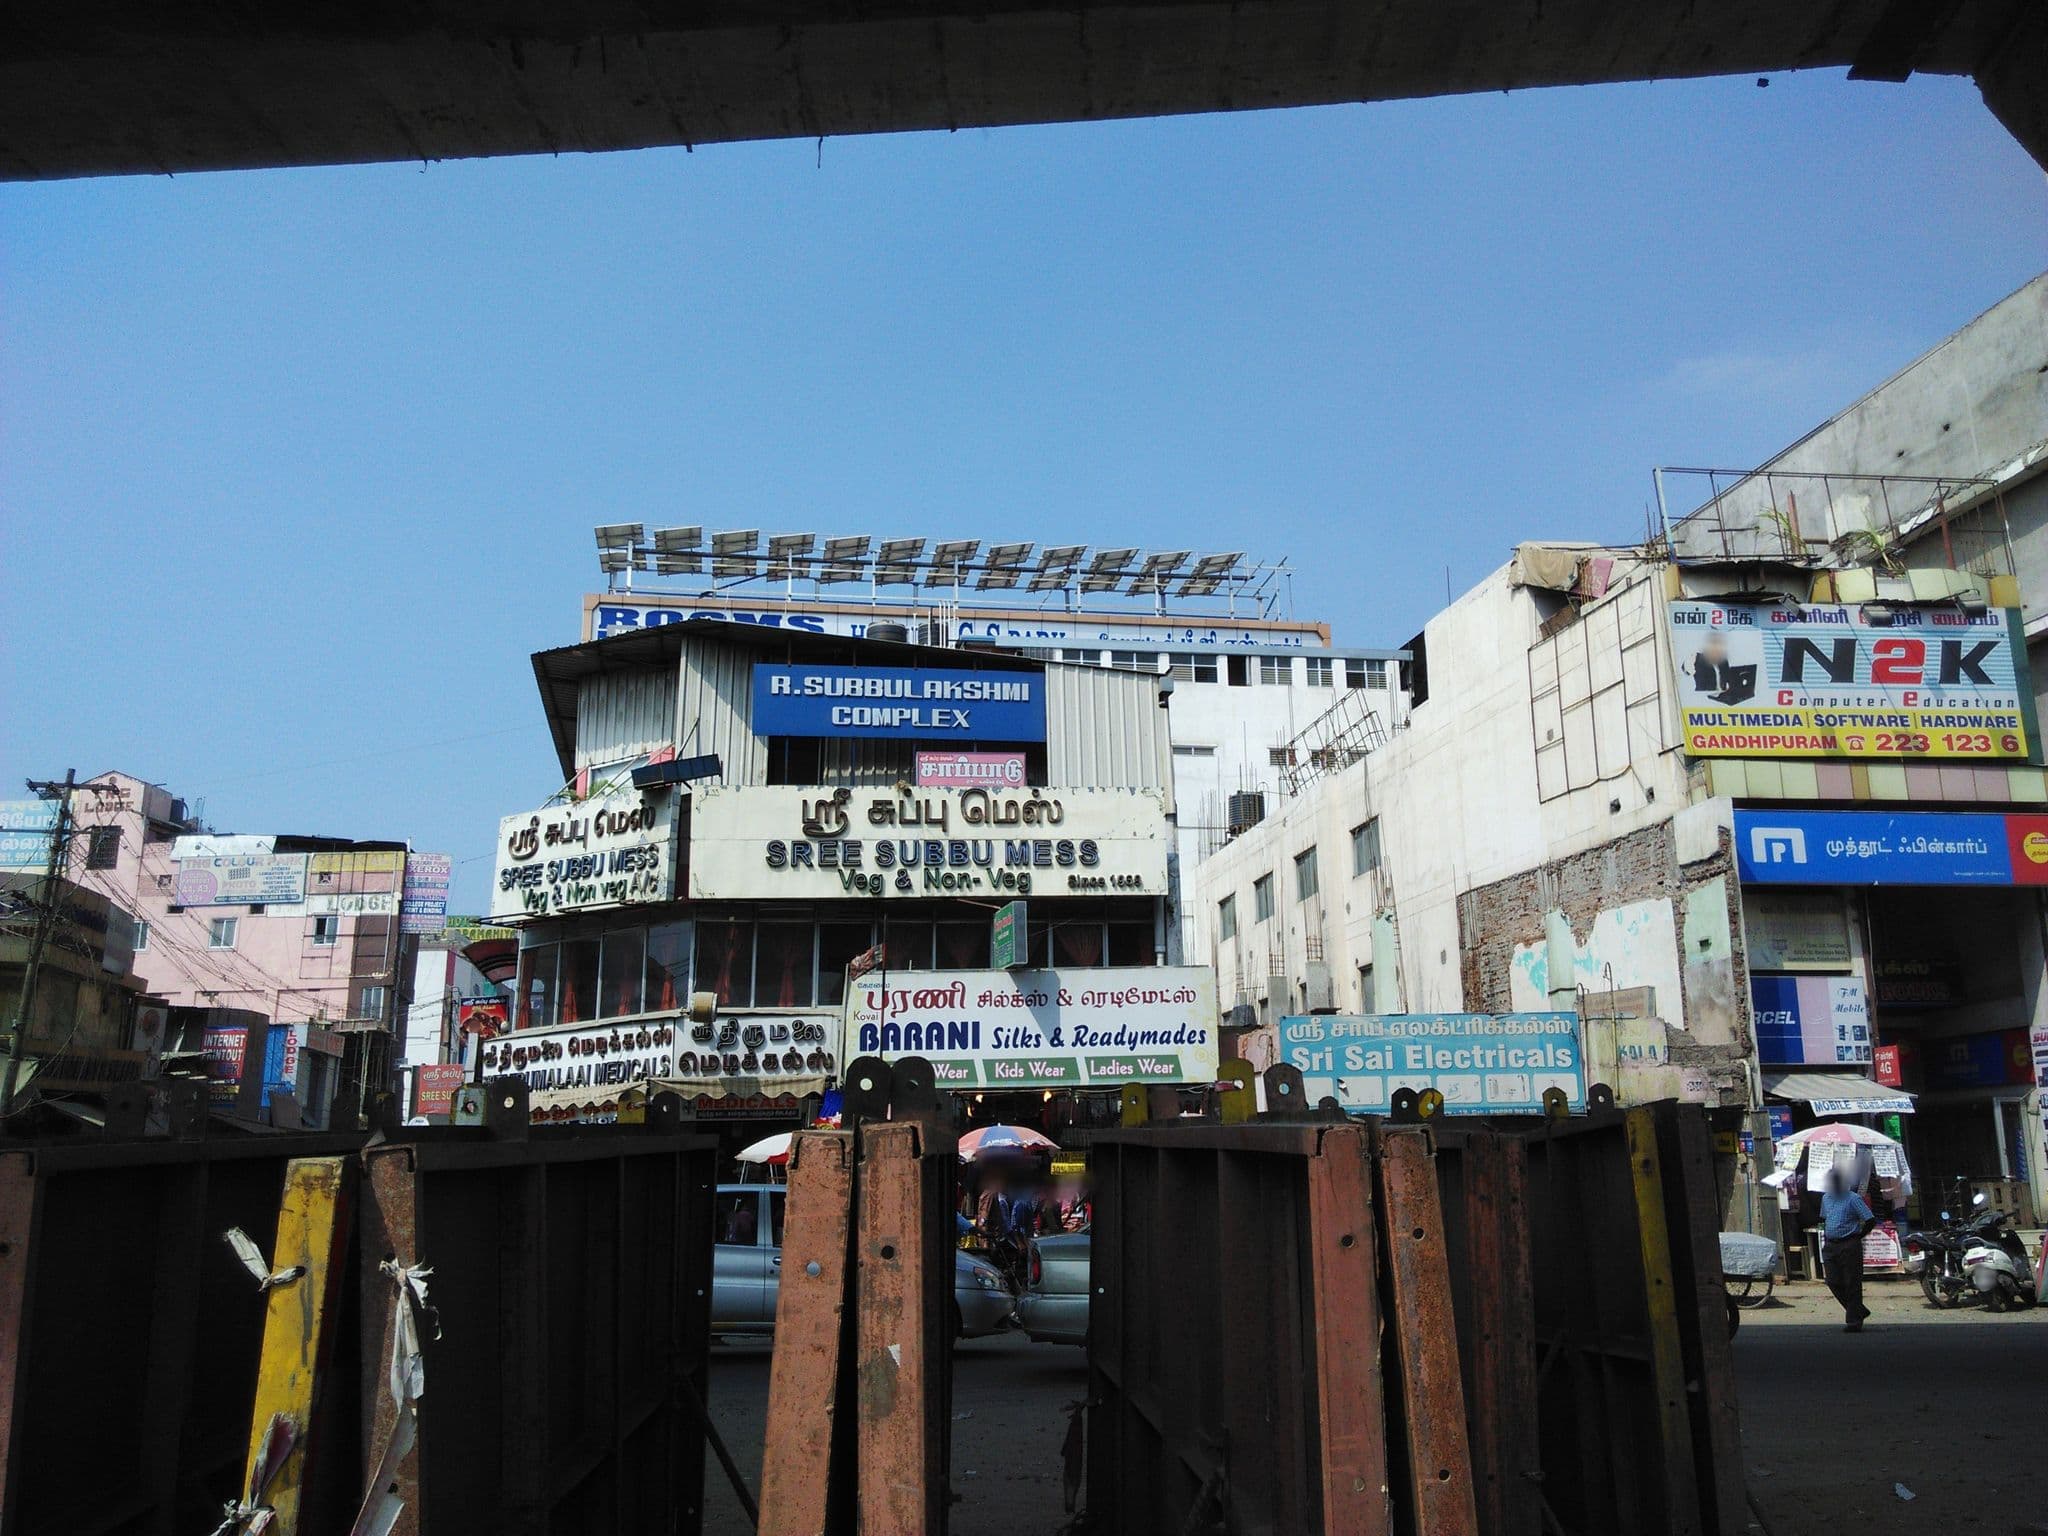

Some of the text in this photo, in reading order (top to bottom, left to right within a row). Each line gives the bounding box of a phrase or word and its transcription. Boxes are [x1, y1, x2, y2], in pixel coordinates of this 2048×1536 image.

[1712, 609, 1722, 625] 2
[1781, 637, 2001, 685] N2K
[831, 706, 970, 728] COMPLEX
[1688, 713, 2018, 728] MULTIMEDIA SOFTWARE HARDWARE
[1692, 733, 2019, 752] GANDHIPURAM 223 123 6
[766, 839, 1100, 867] SREE SUBBU MESS
[213, 857, 263, 868] COLOUR
[409, 865, 448, 873] XEROX
[500, 843, 660, 891] SREE SUBBU MESS
[838, 868, 883, 894] Veg
[895, 868, 913, 889] &
[986, 868, 1032, 894] Veg
[1067, 874, 1106, 888] Since
[327, 895, 393, 911] LODGE
[522, 889, 549, 912] Veg
[552, 884, 563, 907] &
[566, 882, 596, 904] Non
[1056, 988, 1072, 1007] &
[853, 1011, 879, 1021] Kovai
[1835, 1003, 1865, 1013] Mobile
[203, 1034, 246, 1047] INTERNET
[859, 1021, 1207, 1051] BARANI Silks & Readymades
[284, 1031, 298, 1073] LODGE
[1291, 1043, 1573, 1072] Sri Sai Electricals
[593, 1054, 672, 1085] MEDICALS
[932, 1064, 969, 1079] Wear
[995, 1061, 1065, 1078] Kids Wear
[1090, 1058, 1175, 1076] Ladies Wear
[1880, 1061, 1892, 1074] 4G
[421, 1089, 454, 1101] SREE SU
[1814, 1099, 1852, 1112] MOBILE
